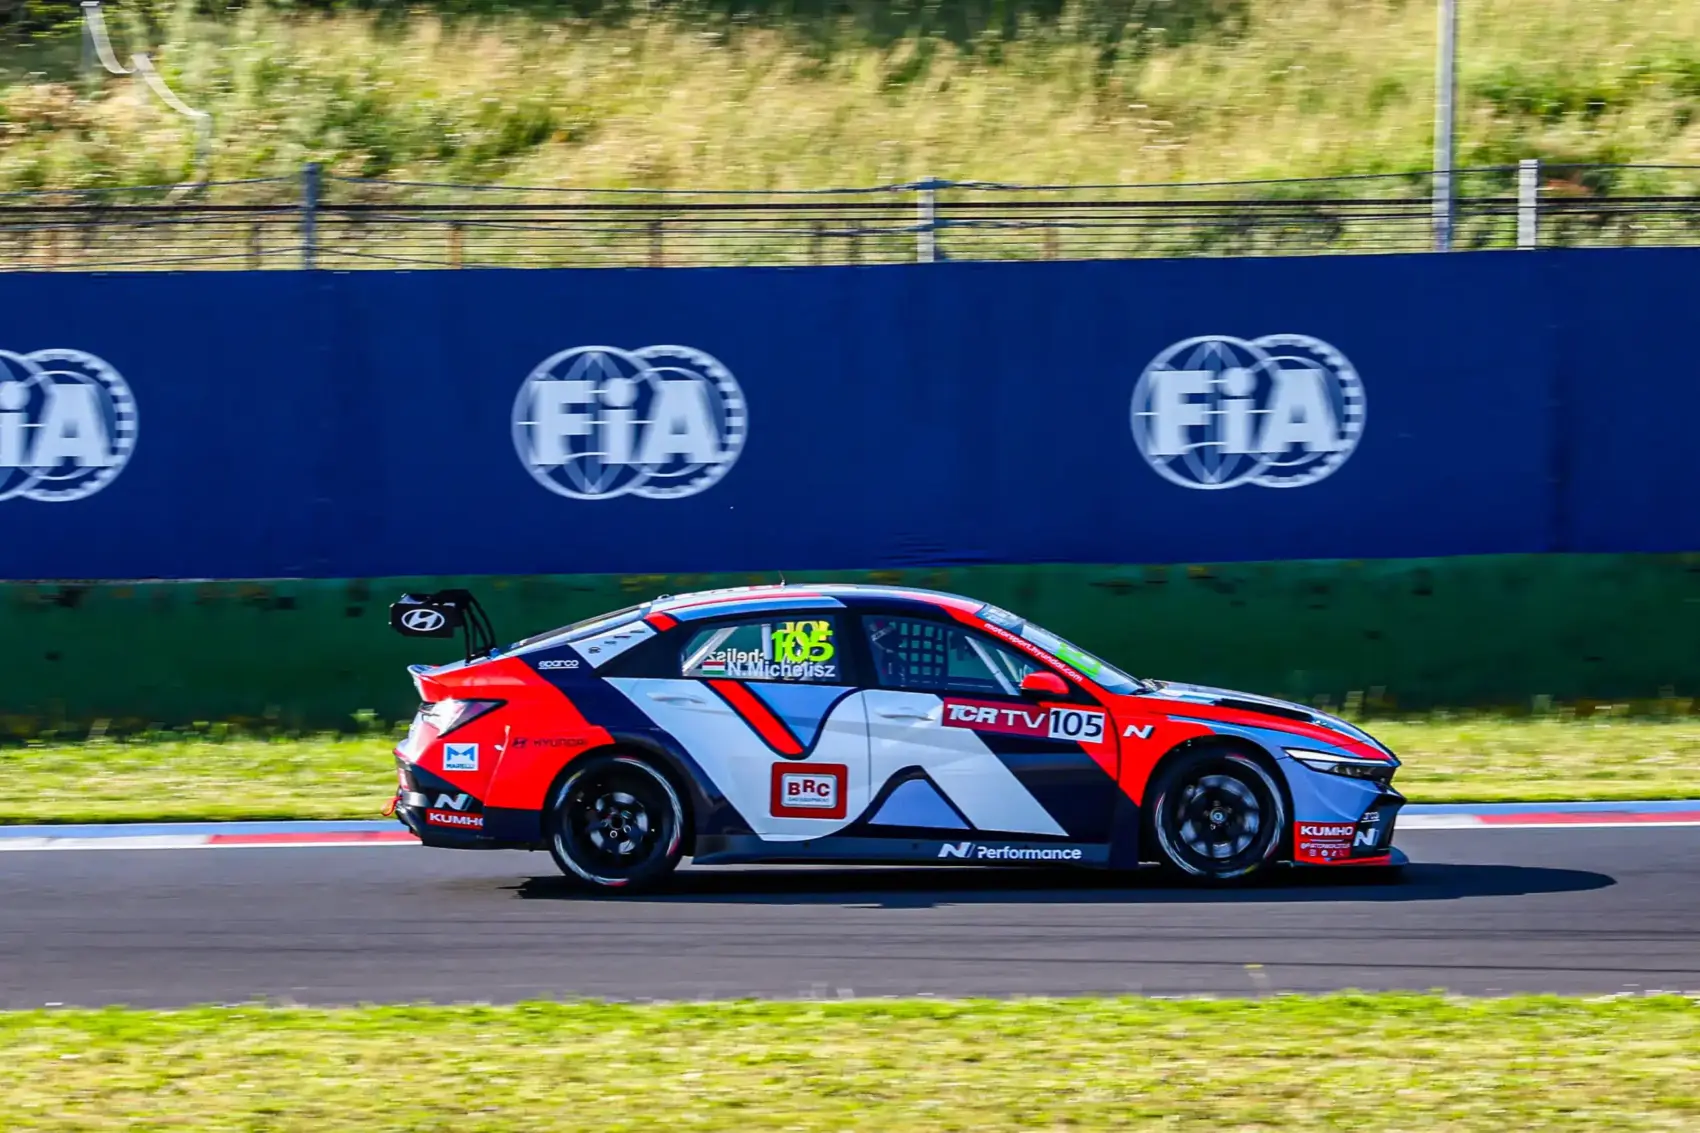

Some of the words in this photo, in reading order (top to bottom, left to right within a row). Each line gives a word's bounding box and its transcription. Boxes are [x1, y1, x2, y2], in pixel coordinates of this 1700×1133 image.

[0, 381, 112, 467] iA
[771, 630, 834, 663] 105
[984, 622, 1083, 682] motorsport.hyundai.com
[538, 660, 579, 669] sparco
[947, 704, 998, 724] TCR
[1001, 709, 1046, 729] TV
[1051, 709, 1102, 737] 105
[788, 779, 830, 797] BRC
[1300, 826, 1353, 836] KUMHO
[977, 846, 1082, 859] Performance
